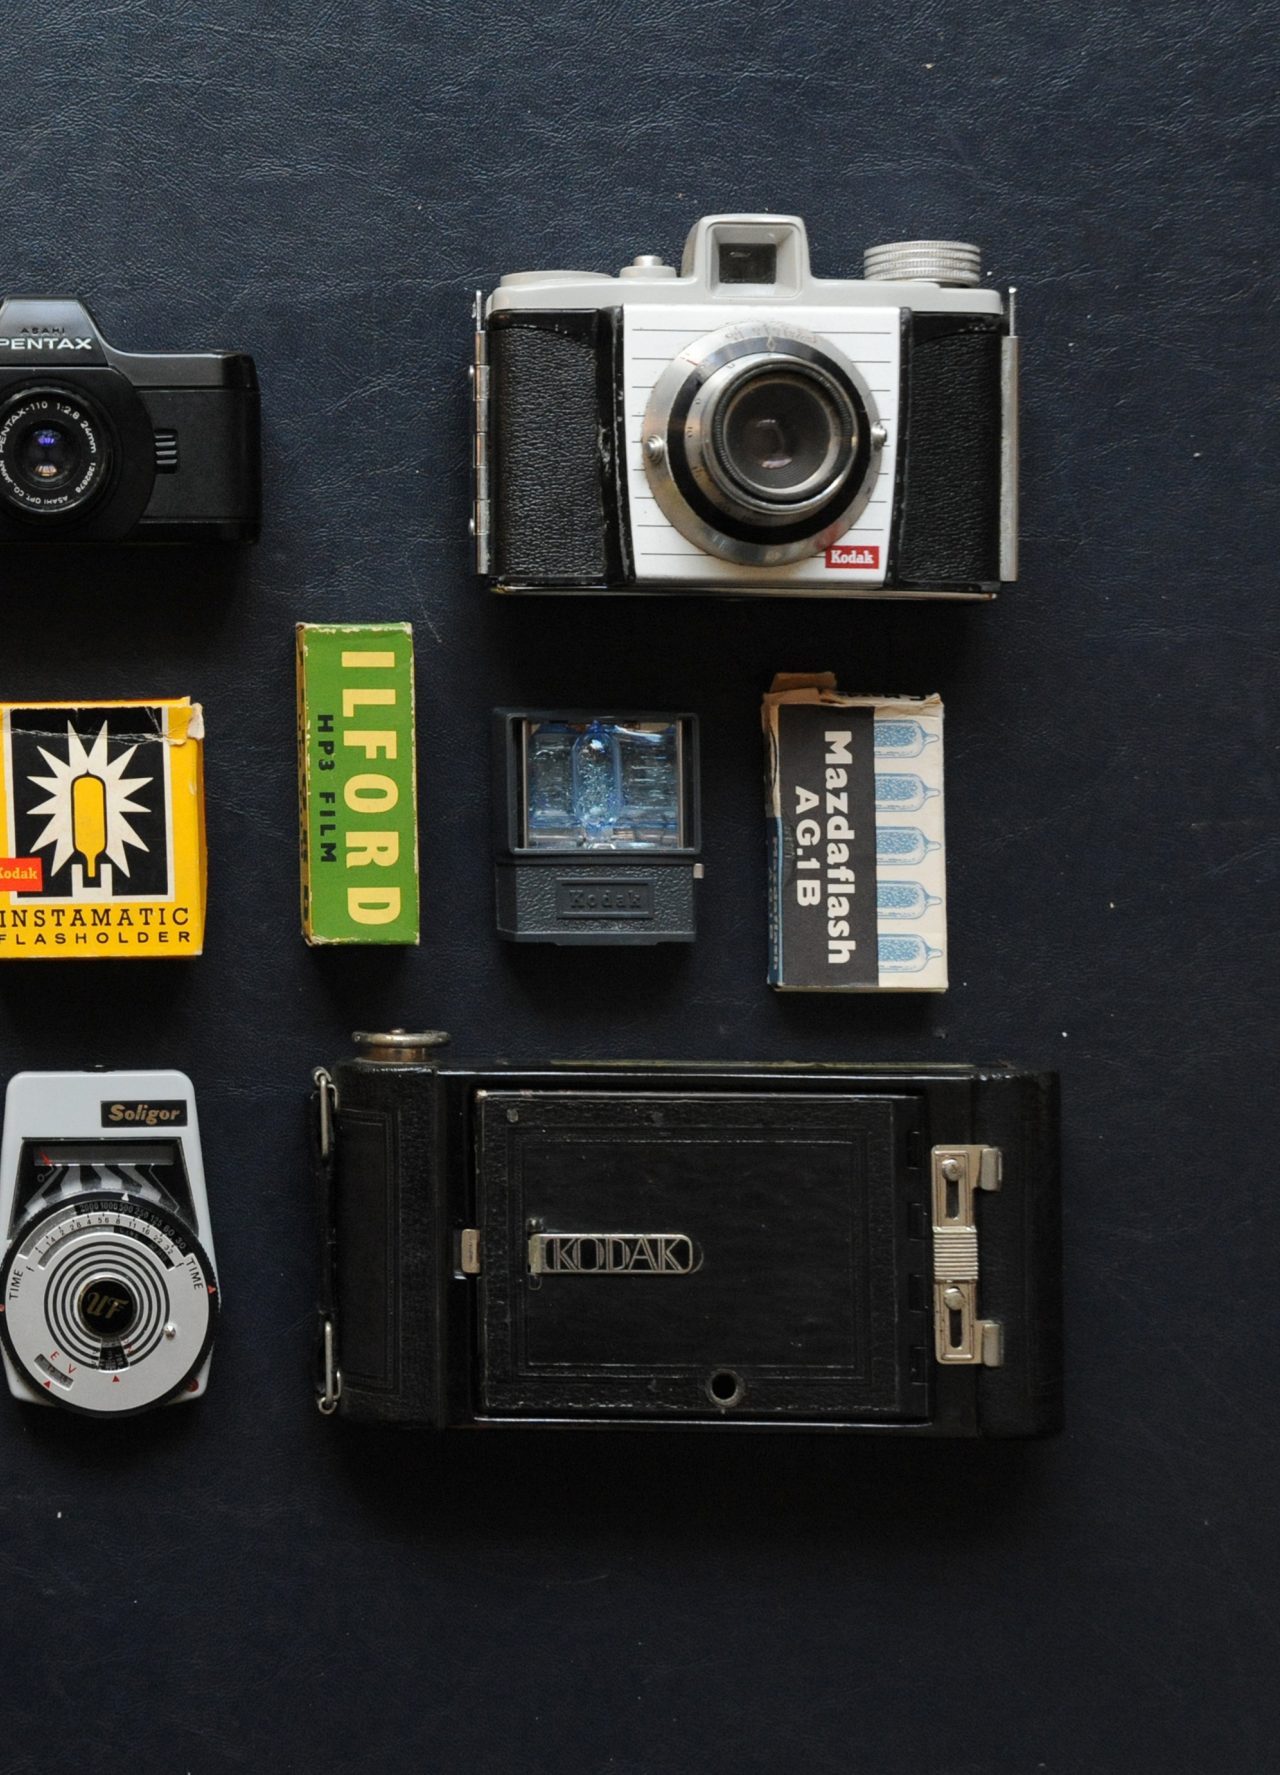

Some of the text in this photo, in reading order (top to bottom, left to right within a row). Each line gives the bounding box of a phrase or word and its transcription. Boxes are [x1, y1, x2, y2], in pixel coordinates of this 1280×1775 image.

[20, 326, 66, 335] ASAHI
[56, 402, 80, 420] 1:2.8
[80, 420, 97, 454] 24mm
[43, 495, 69, 505] ASAHI
[830, 549, 875, 564] Kodak
[317, 714, 337, 863] HP3 FILM
[340, 651, 401, 925] ILFORD
[823, 730, 856, 964] Mazdaflash
[568, 889, 642, 910] Kodak
[0, 907, 190, 928] INSTAMATIC
[107, 1103, 181, 1126] Soligor
[552, 1237, 684, 1272] KODAK
[8, 1268, 25, 1301] TIME
[184, 1257, 204, 1291] TIME
